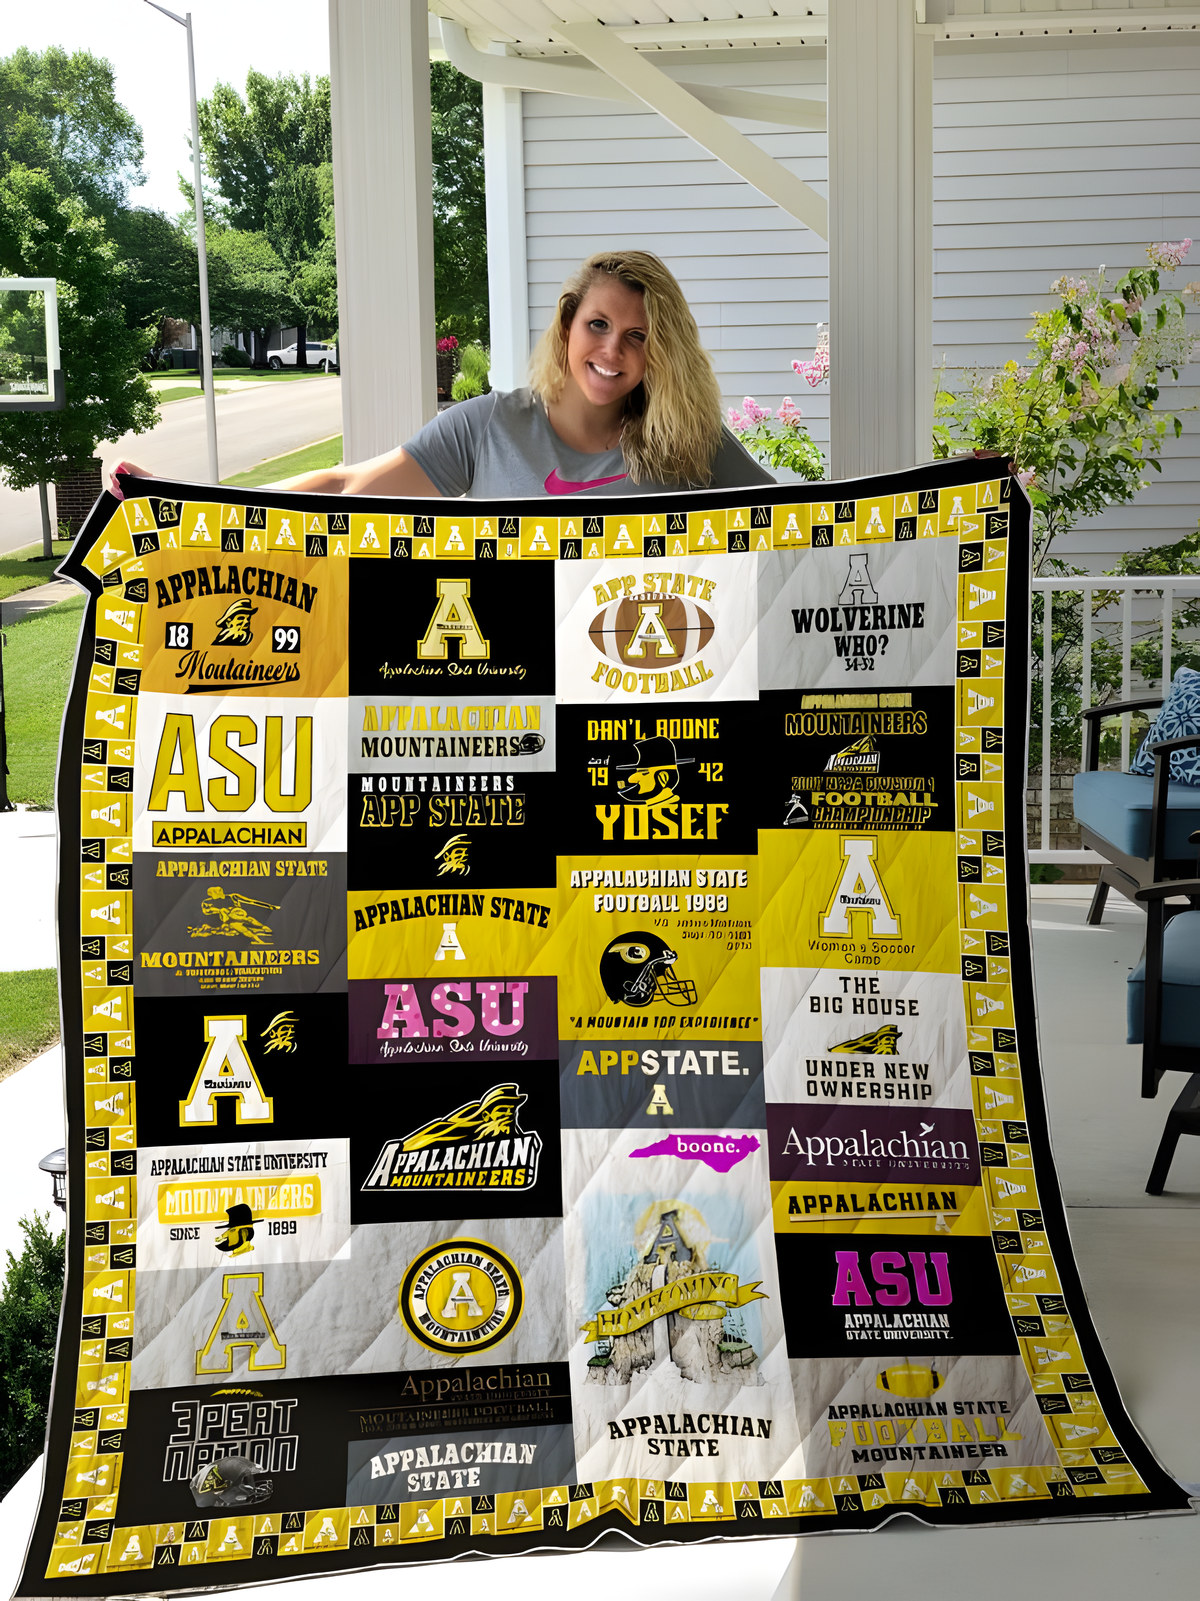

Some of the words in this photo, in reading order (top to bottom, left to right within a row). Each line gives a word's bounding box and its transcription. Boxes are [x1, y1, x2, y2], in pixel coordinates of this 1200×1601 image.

[155, 566, 318, 613] APPALACHIAN
[838, 553, 878, 605] A
[417, 579, 490, 659] A
[792, 602, 924, 633] WOLVERINE
[168, 625, 189, 647] 18
[275, 629, 298, 650] 99
[624, 603, 678, 658] A
[834, 635, 889, 657] WHO?
[588, 719, 646, 740] DAN'L
[785, 711, 927, 735] MOUNTAINEERS
[361, 737, 520, 757] MOUNTAINEERS
[147, 713, 313, 812] ASU
[588, 767, 608, 786] 19
[698, 762, 723, 782] 42
[361, 776, 514, 792] MOUNTAINEERS
[360, 795, 420, 827] APP
[429, 793, 525, 827] STATE
[811, 792, 938, 807] FOOTBALL
[595, 803, 729, 840] YOSEF
[156, 828, 302, 844] APPALACHIAN
[156, 861, 270, 877] APPALACHIAN
[276, 861, 327, 876] STATE
[571, 870, 691, 888] APPALACHIAN
[696, 870, 747, 888] STATE
[819, 835, 902, 939] A
[354, 894, 485, 932] APPALACHIAN
[490, 897, 551, 929] STATE
[594, 894, 680, 912] FOOTBALL
[434, 923, 466, 960] A
[140, 950, 320, 968] MOUNTAINEERS
[839, 977, 880, 994] THE
[377, 982, 528, 1039] ASU
[810, 996, 843, 1013] BIG
[853, 998, 919, 1016] HOUSE
[179, 1015, 274, 1127] A
[806, 1060, 875, 1078] UNDER
[884, 1063, 929, 1080] NEW
[646, 1084, 674, 1115] A
[806, 1080, 932, 1100] OWNERSHIP
[782, 1122, 970, 1166] Appalachian
[228, 1155, 261, 1172] STATE
[368, 1136, 532, 1186] APPALACHIAN
[390, 1169, 526, 1187] MOUNTAINEERS
[788, 1192, 957, 1214] APPALACHIAN
[414, 1253, 484, 1300] APPALACHIAN
[832, 1251, 953, 1306] ASU
[441, 1272, 483, 1317] A
[195, 1272, 286, 1375] A
[845, 1314, 950, 1328] APPALACHIAN
[401, 1368, 550, 1402] Appalachian
[828, 1402, 947, 1419] APPALACHIAN
[953, 1400, 1010, 1415] STATE
[608, 1414, 772, 1439] APPALACHIAN
[647, 1438, 719, 1456] STATE
[852, 1444, 1008, 1463] MOUNTAINEER
[370, 1442, 537, 1479] APPALACHIAN
[408, 1467, 480, 1493] STATE
